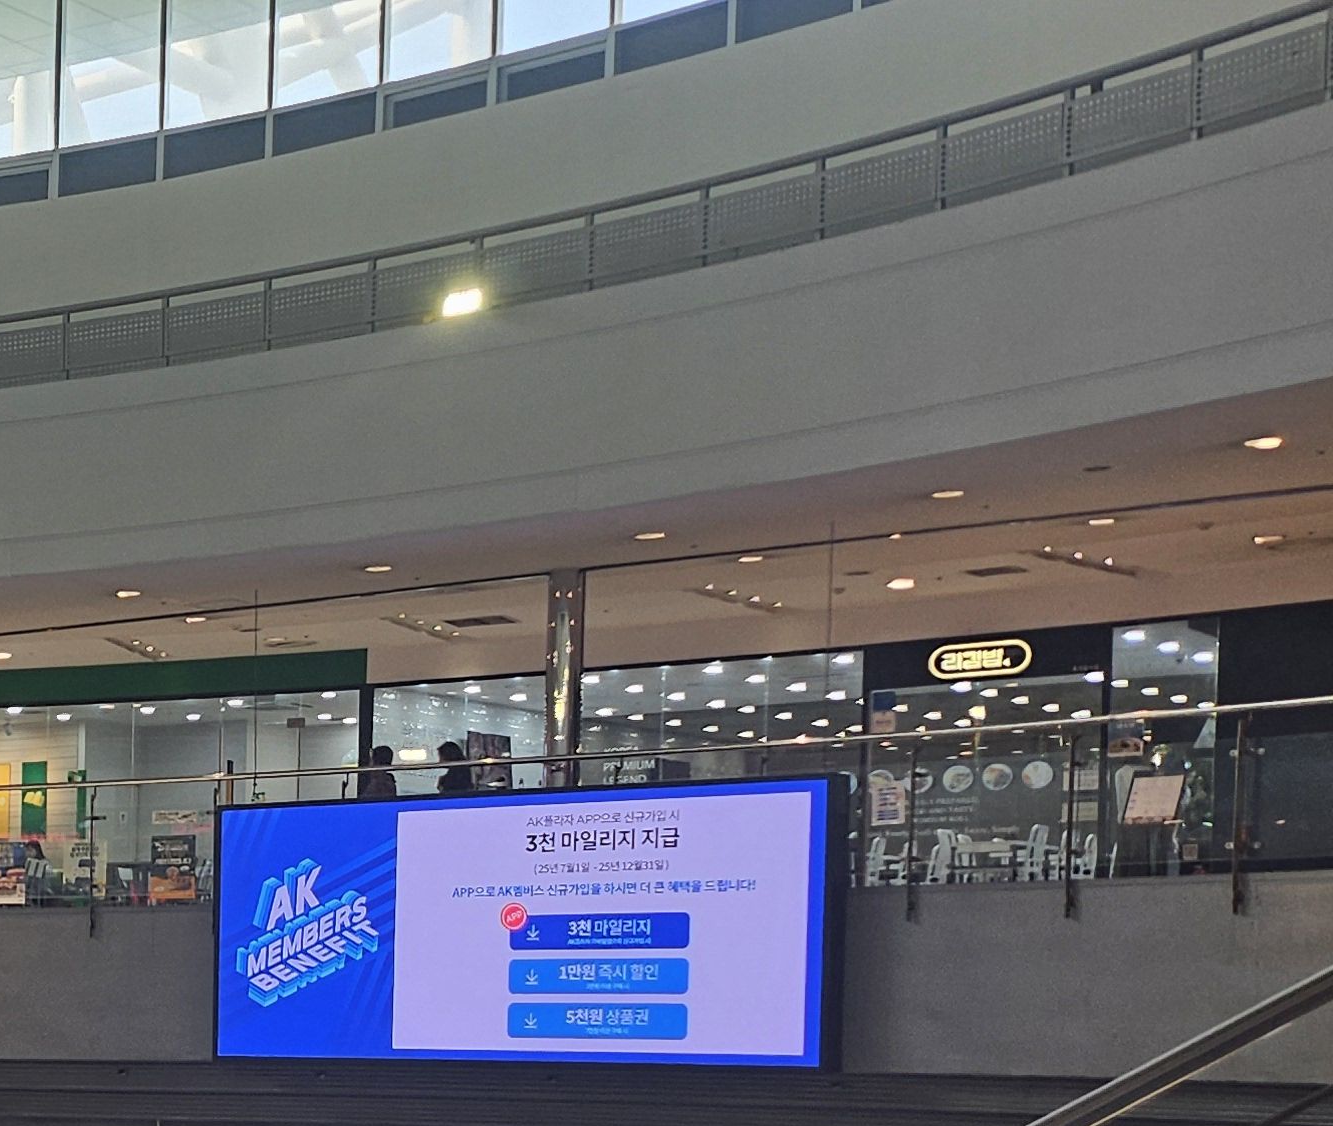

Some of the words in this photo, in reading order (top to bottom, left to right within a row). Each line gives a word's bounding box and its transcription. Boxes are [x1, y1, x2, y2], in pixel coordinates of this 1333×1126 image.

[576, 812, 621, 825] APP으로
[623, 810, 667, 824] 신규가입
[669, 809, 681, 821] 시
[525, 831, 556, 853] 3천
[561, 829, 636, 851] 마일리지
[641, 827, 680, 849] 지급
[261, 862, 322, 931] AK
[453, 886, 495, 898] APP으로
[497, 884, 545, 897] AK멤버스
[546, 883, 601, 896] 신규가입을
[603, 882, 637, 895] 하시면
[639, 881, 651, 894] 더
[654, 881, 665, 894] 큰
[704, 879, 756, 893] 드립니다!
[506, 910, 522, 923] APP
[244, 893, 368, 977] MEMBERS
[568, 919, 592, 936] 3천
[594, 919, 651, 935] 마일리지
[248, 920, 379, 993] BENEFIT
[558, 964, 596, 981] 1만원
[599, 964, 627, 980] 즉시
[630, 964, 659, 980] 할인
[565, 1009, 603, 1025] 5천원
[606, 1008, 649, 1025] 상품권
